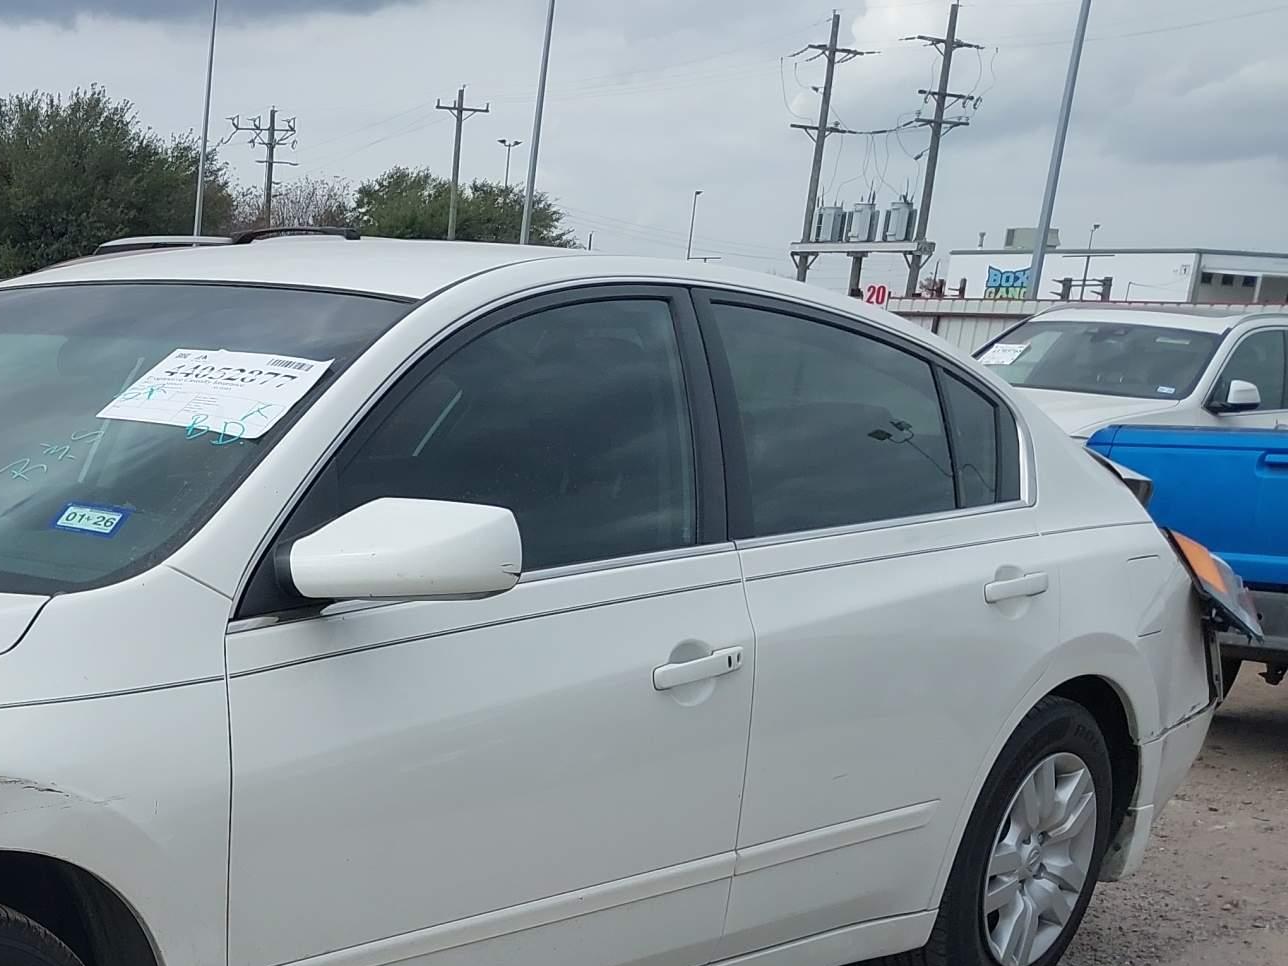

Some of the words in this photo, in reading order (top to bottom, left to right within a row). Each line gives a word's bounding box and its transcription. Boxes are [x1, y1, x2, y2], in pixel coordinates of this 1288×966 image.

[986, 266, 1032, 288] BOX
[866, 285, 887, 305] 20
[164, 363, 298, 389] 44052877
